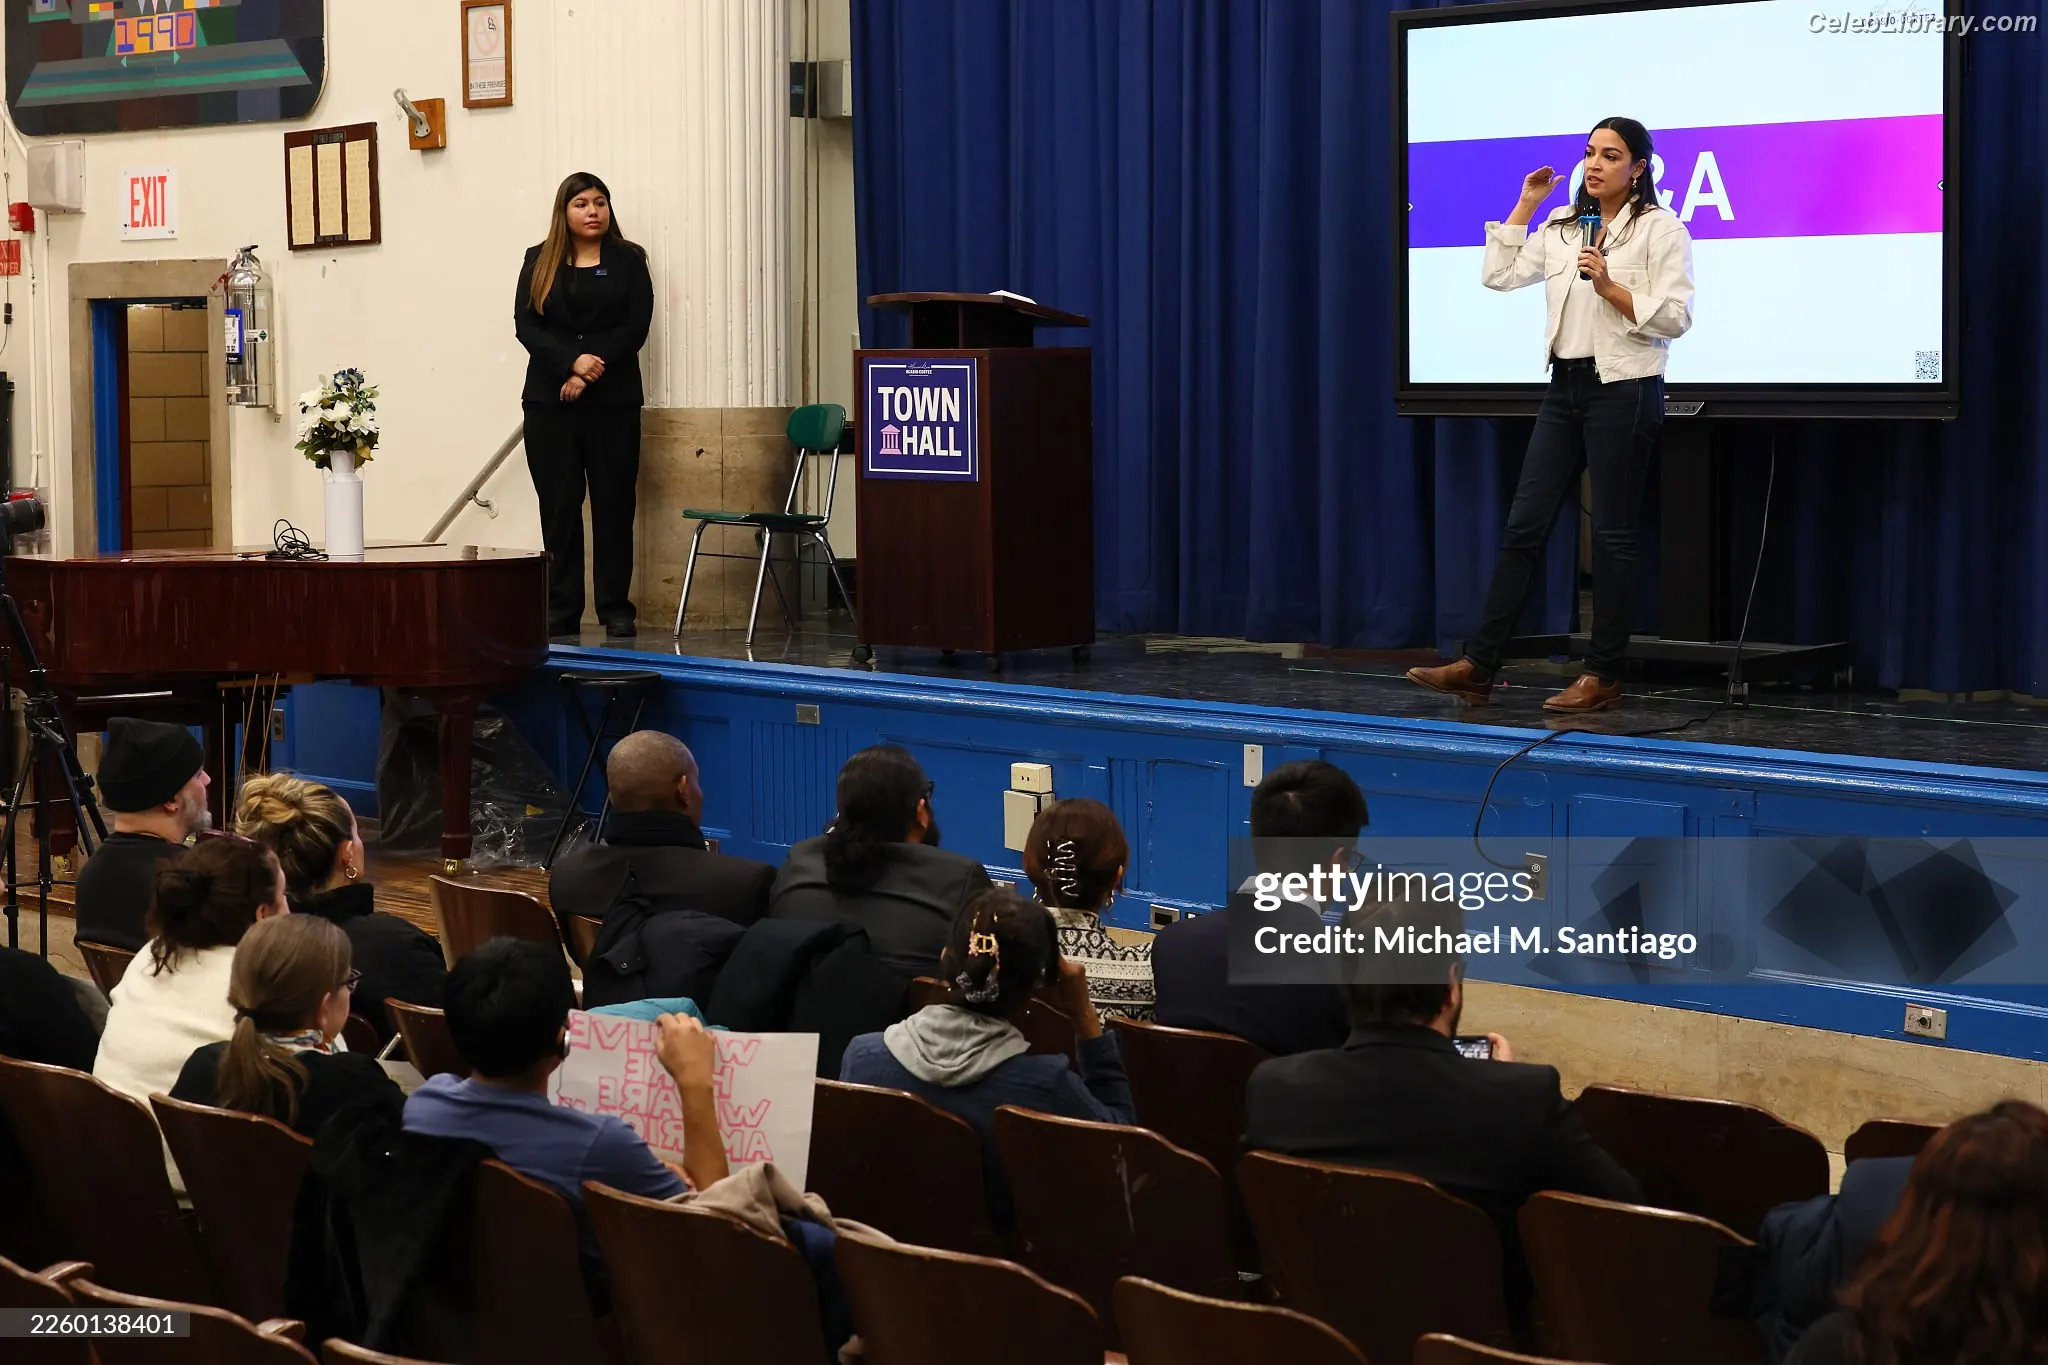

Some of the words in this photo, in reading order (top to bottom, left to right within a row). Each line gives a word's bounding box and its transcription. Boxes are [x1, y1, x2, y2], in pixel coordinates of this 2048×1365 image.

[116, 12, 196, 53] 1990
[131, 175, 167, 228] EXIT
[878, 387, 960, 422] TOWN
[902, 425, 962, 456] HALL
